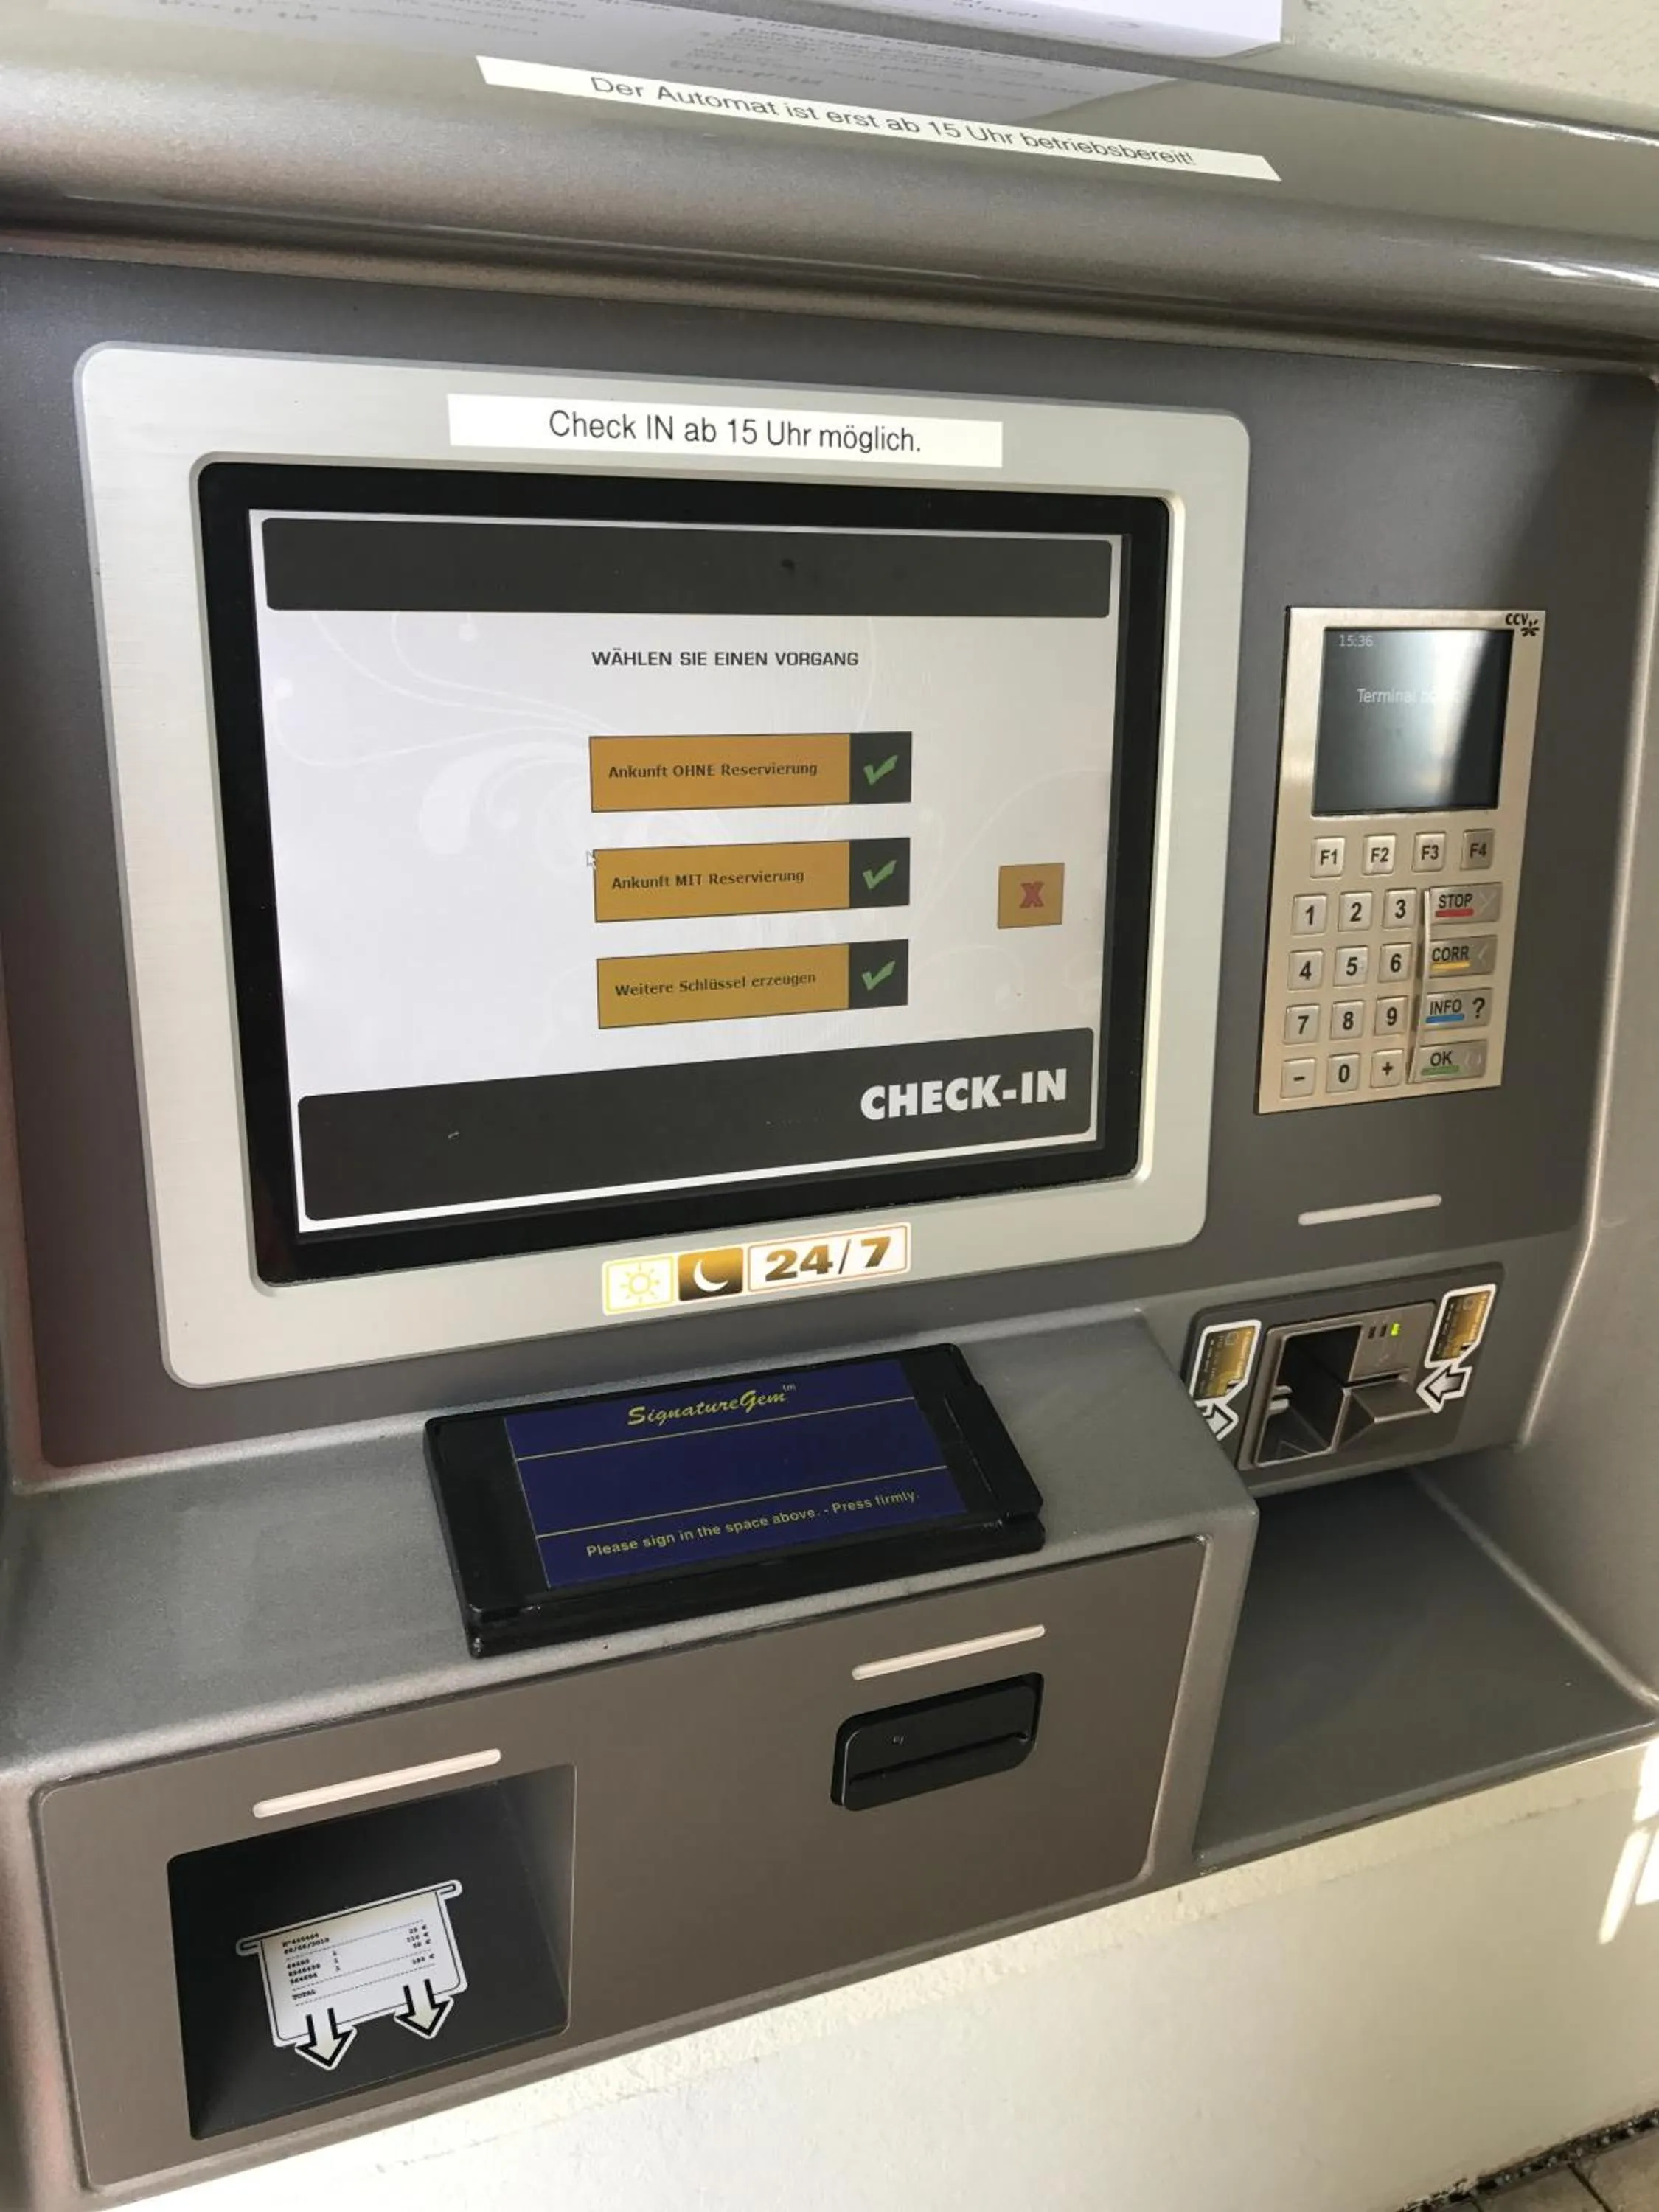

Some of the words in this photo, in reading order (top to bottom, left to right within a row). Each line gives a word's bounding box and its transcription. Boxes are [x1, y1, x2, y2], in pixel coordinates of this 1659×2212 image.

[591, 75, 644, 97] Der
[657, 85, 779, 116] Automat
[787, 102, 818, 120] ist
[826, 110, 878, 128] erst
[887, 116, 920, 133] ab
[928, 120, 961, 139] 15
[967, 125, 1014, 145] Uhr
[1022, 131, 1196, 166] betriebsbereit!
[549, 408, 637, 440] Check
[647, 414, 674, 442] IN
[684, 417, 717, 443] ab
[727, 418, 757, 444] 15
[766, 420, 811, 446] Uhr
[818, 423, 922, 453] möglich.
[1505, 613, 1529, 626] CCV
[1338, 634, 1374, 647] 15:36
[591, 647, 672, 666] WÄHLEN
[680, 651, 707, 666] SIE
[714, 651, 768, 666] EINEN
[775, 651, 859, 666] VORGANG
[1357, 687, 1417, 703] Terminal
[608, 764, 668, 779] Ankunft
[672, 764, 715, 777] OHNE
[721, 761, 818, 776] Reservierung
[1320, 849, 1338, 866] F1
[1371, 847, 1389, 863] F2
[1421, 844, 1439, 860] F3
[1470, 843, 1487, 858] F4
[611, 875, 670, 890] Ankunft
[675, 874, 703, 886] MIT
[709, 870, 804, 885] Reservierung
[1305, 905, 1315, 925] 1
[1350, 902, 1363, 922] 2
[1394, 899, 1407, 919] 3
[1438, 893, 1473, 909] STOP
[1431, 945, 1470, 963] CORR
[1299, 961, 1312, 981] 4
[1346, 956, 1357, 976] 5
[1390, 953, 1402, 973] 6
[615, 983, 674, 997] Weitere
[679, 975, 746, 992] Schlüssel
[751, 972, 816, 987] erzeugen
[1430, 998, 1462, 1015] INFO
[1472, 996, 1486, 1019] ?
[1298, 1015, 1310, 1035] 7
[1342, 1011, 1354, 1031] 8
[1386, 1006, 1398, 1026] 9
[1430, 1050, 1453, 1067] OK
[1338, 1063, 1351, 1083] 0
[860, 1067, 1068, 1121] CHECK-IN
[765, 1235, 892, 1282] 24/7
[627, 1389, 786, 1427] SignatureGem
[585, 1537, 639, 1558] Please
[642, 1531, 675, 1549] sign
[679, 1528, 694, 1541] in
[697, 1524, 721, 1538] the
[725, 1517, 769, 1534] space
[772, 1509, 821, 1526] above.
[832, 1498, 872, 1514] Press
[875, 1489, 920, 1506] firmly.
